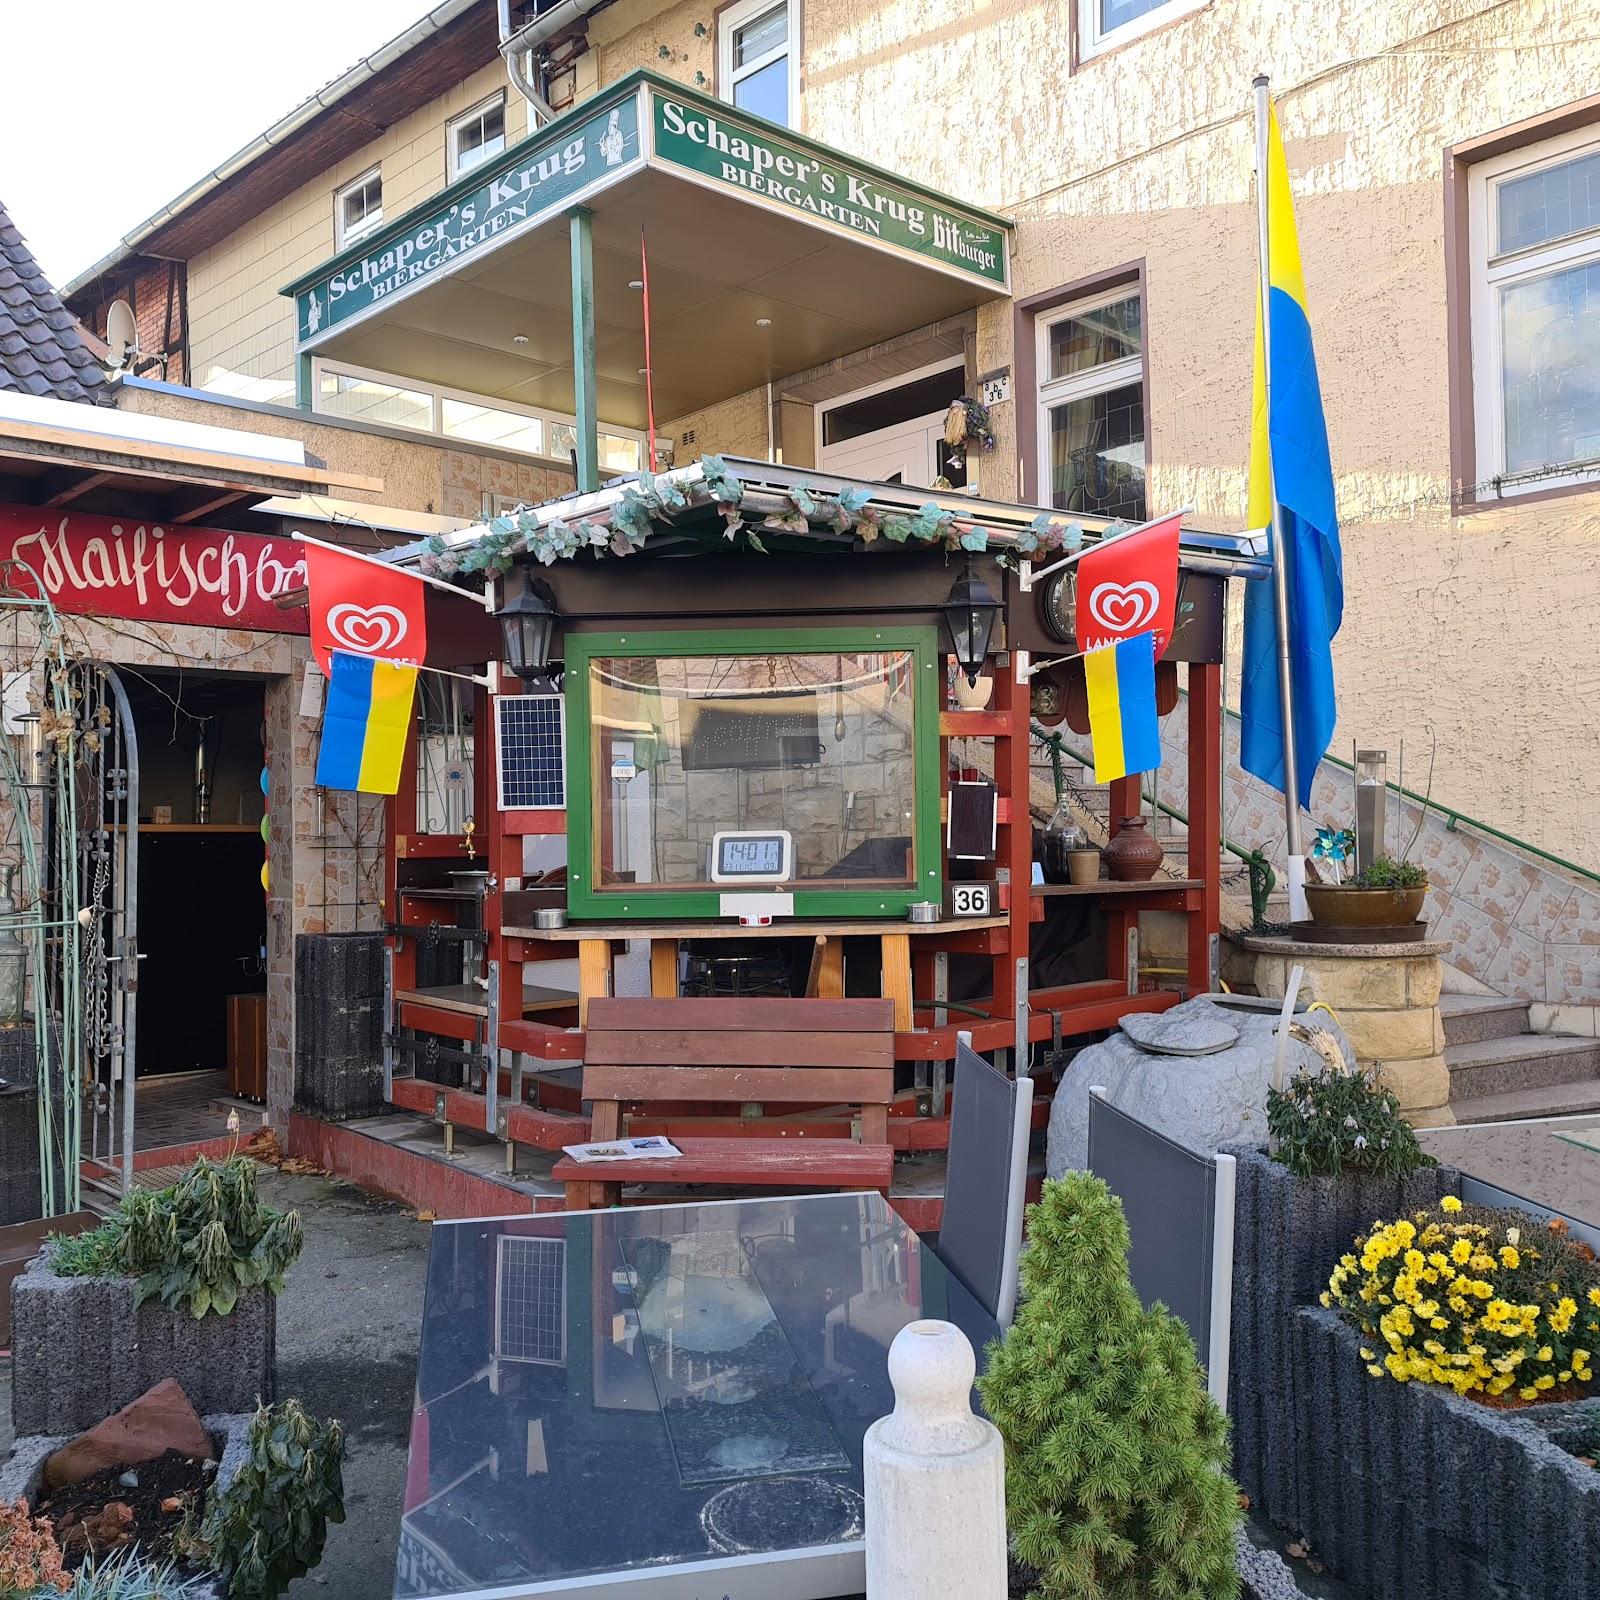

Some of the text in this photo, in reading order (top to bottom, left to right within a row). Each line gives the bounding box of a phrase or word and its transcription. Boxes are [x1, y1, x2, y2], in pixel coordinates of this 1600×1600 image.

[662, 101, 925, 235] Schaper's Krug
[720, 161, 880, 236] BIERGARTEN
[328, 135, 586, 303] Schaper's Krug
[372, 199, 527, 302] BIERGARTEN
[932, 213, 996, 271] Bitburger
[989, 389, 1003, 402] 36
[11, 516, 308, 617] Haifischba
[616, 767, 631, 777] ring
[958, 890, 985, 912] 36
